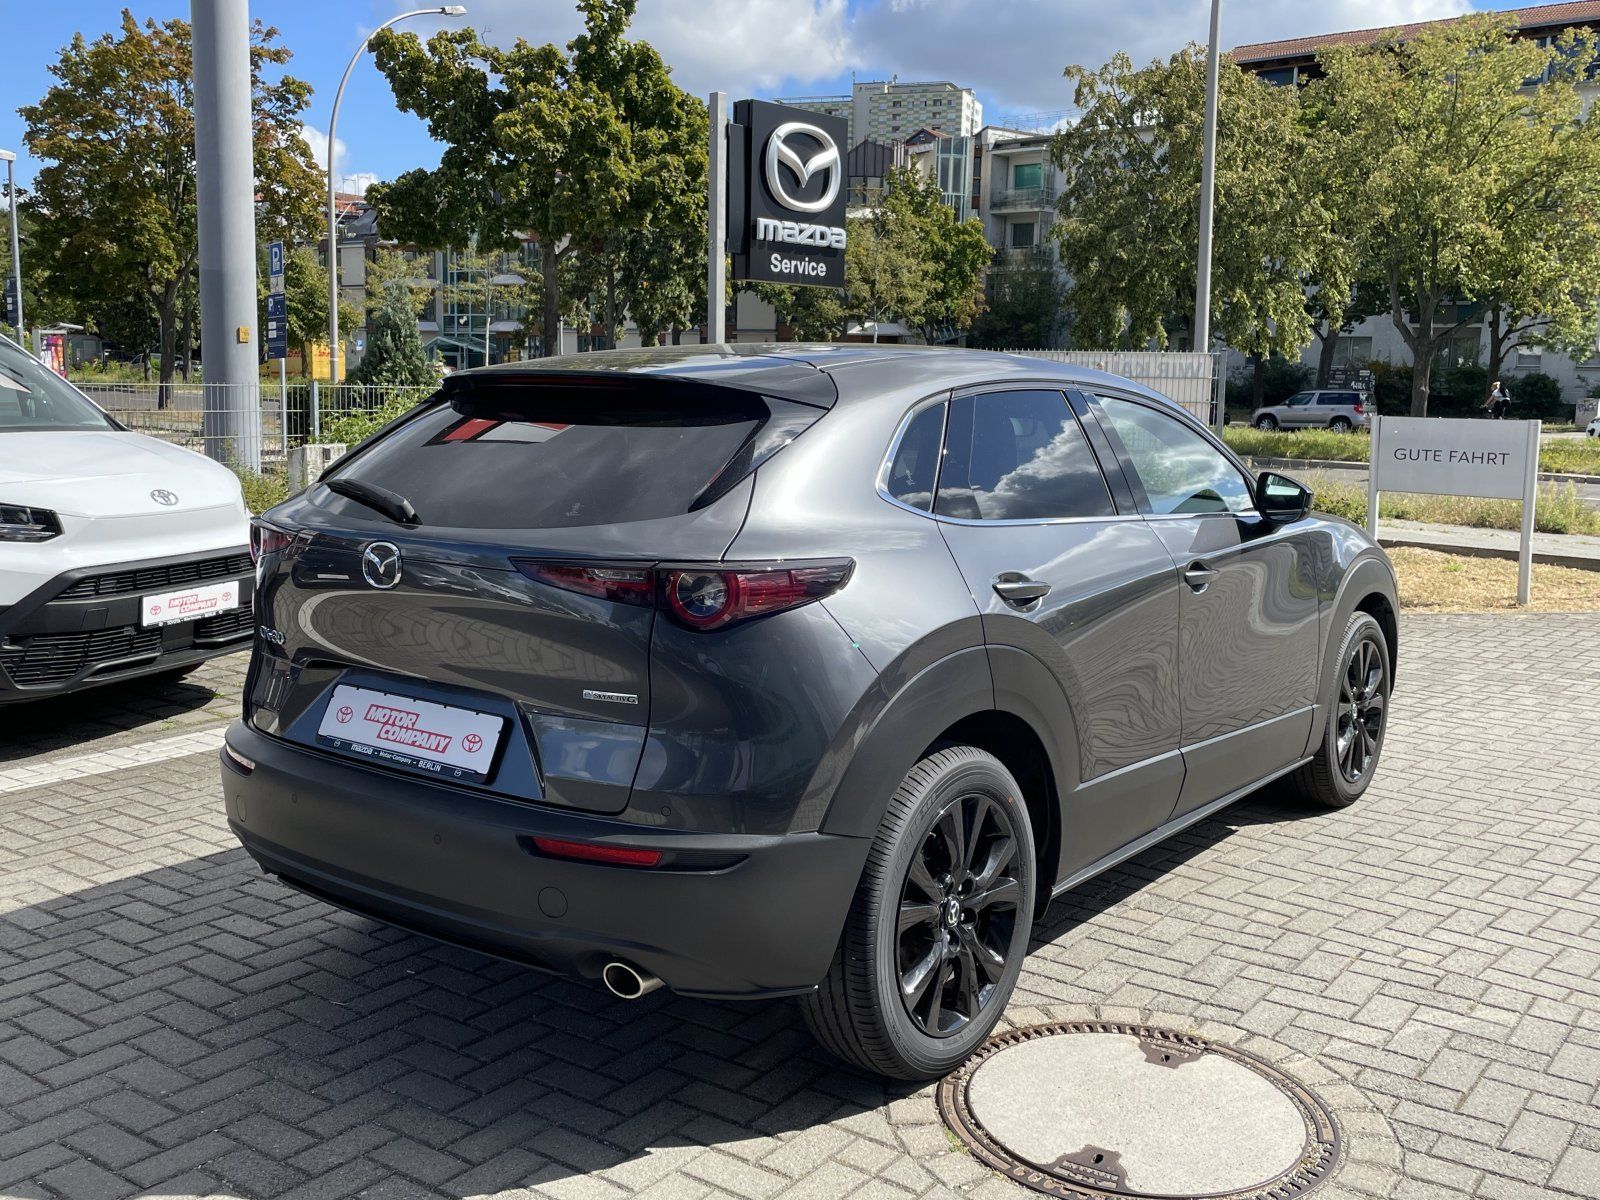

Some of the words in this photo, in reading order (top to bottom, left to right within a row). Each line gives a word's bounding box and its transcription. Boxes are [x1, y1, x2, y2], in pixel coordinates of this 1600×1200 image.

[757, 217, 847, 249] mazda
[770, 253, 827, 276] Service
[1393, 447, 1443, 463] GUTE
[1448, 450, 1511, 466] FAHRT
[170, 595, 199, 608] MOTOR
[180, 599, 217, 613] COMPANY
[367, 705, 416, 728] MOTOR
[379, 725, 451, 753] COMPANY
[380, 750, 411, 764] Motor-Company
[418, 760, 442, 772] BERLIN
